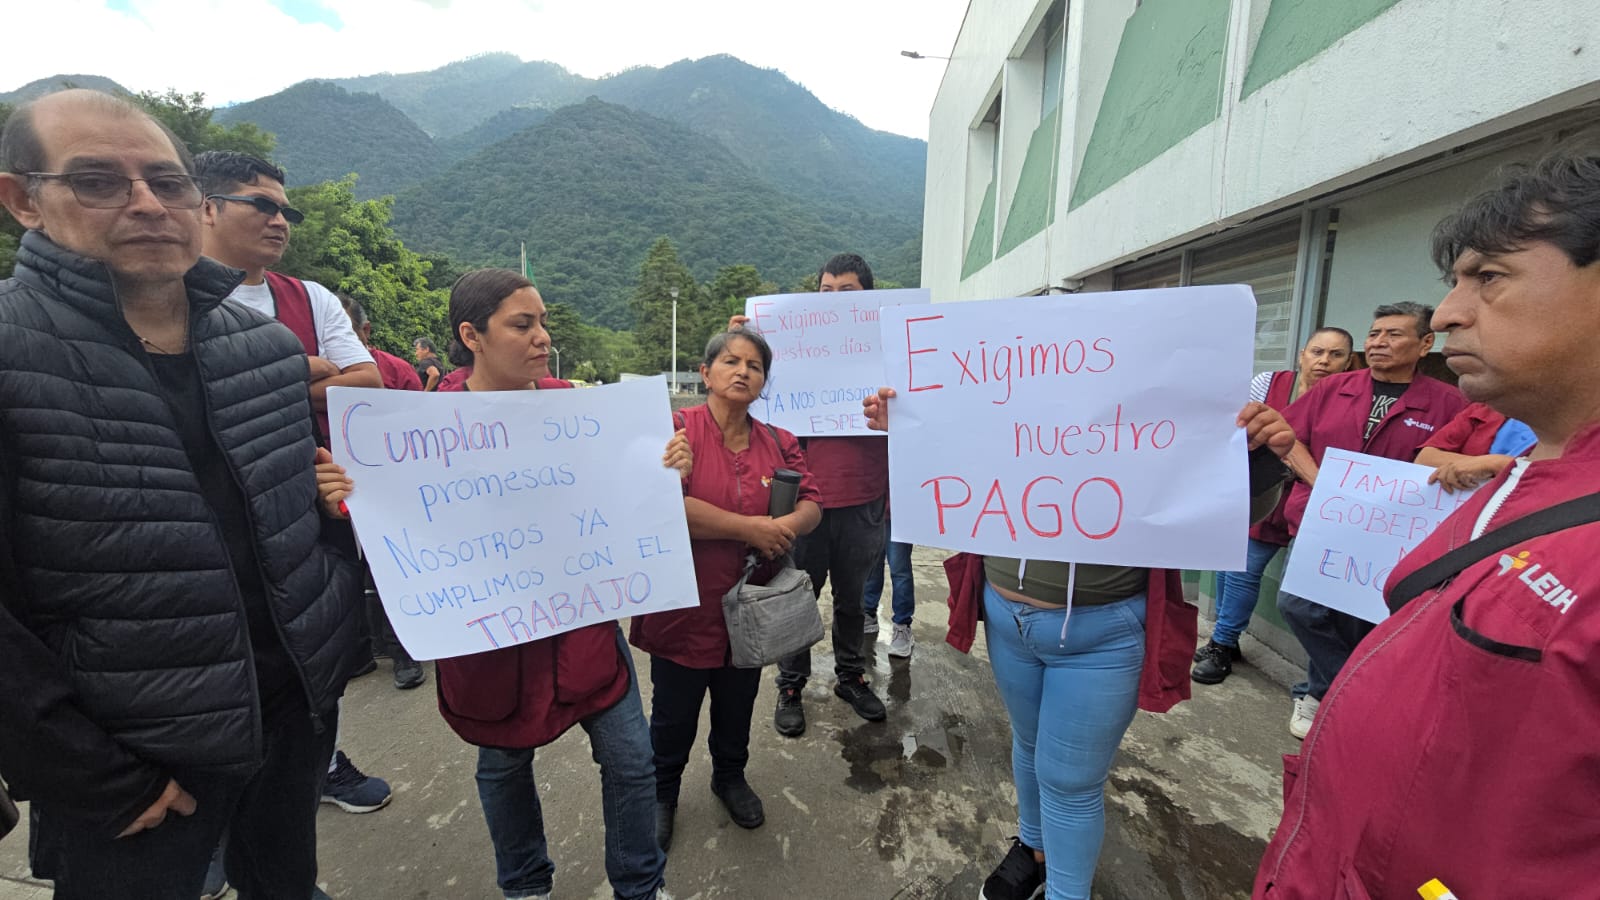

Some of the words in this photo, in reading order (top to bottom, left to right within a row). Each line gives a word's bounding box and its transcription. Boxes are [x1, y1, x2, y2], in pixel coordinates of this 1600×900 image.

[755, 303, 838, 336] Exigimos
[850, 303, 880, 323] tam
[772, 340, 831, 361] uestros
[906, 315, 1114, 404] Exigimos
[790, 391, 816, 411] NOS
[820, 386, 876, 404] cansam
[810, 414, 867, 433] ESPE
[341, 400, 509, 468] Cumplan
[1014, 403, 1176, 457] nuestro
[418, 462, 576, 522] promesas
[920, 475, 1124, 541] PAGO
[1319, 496, 1442, 540] GOBER
[570, 508, 609, 538] YA
[399, 569, 544, 617] CUMPLIMOS
[563, 545, 614, 577] CON
[636, 534, 672, 559] EL
[1518, 563, 1578, 614] LEIH
[466, 571, 651, 648] TRABAJO
